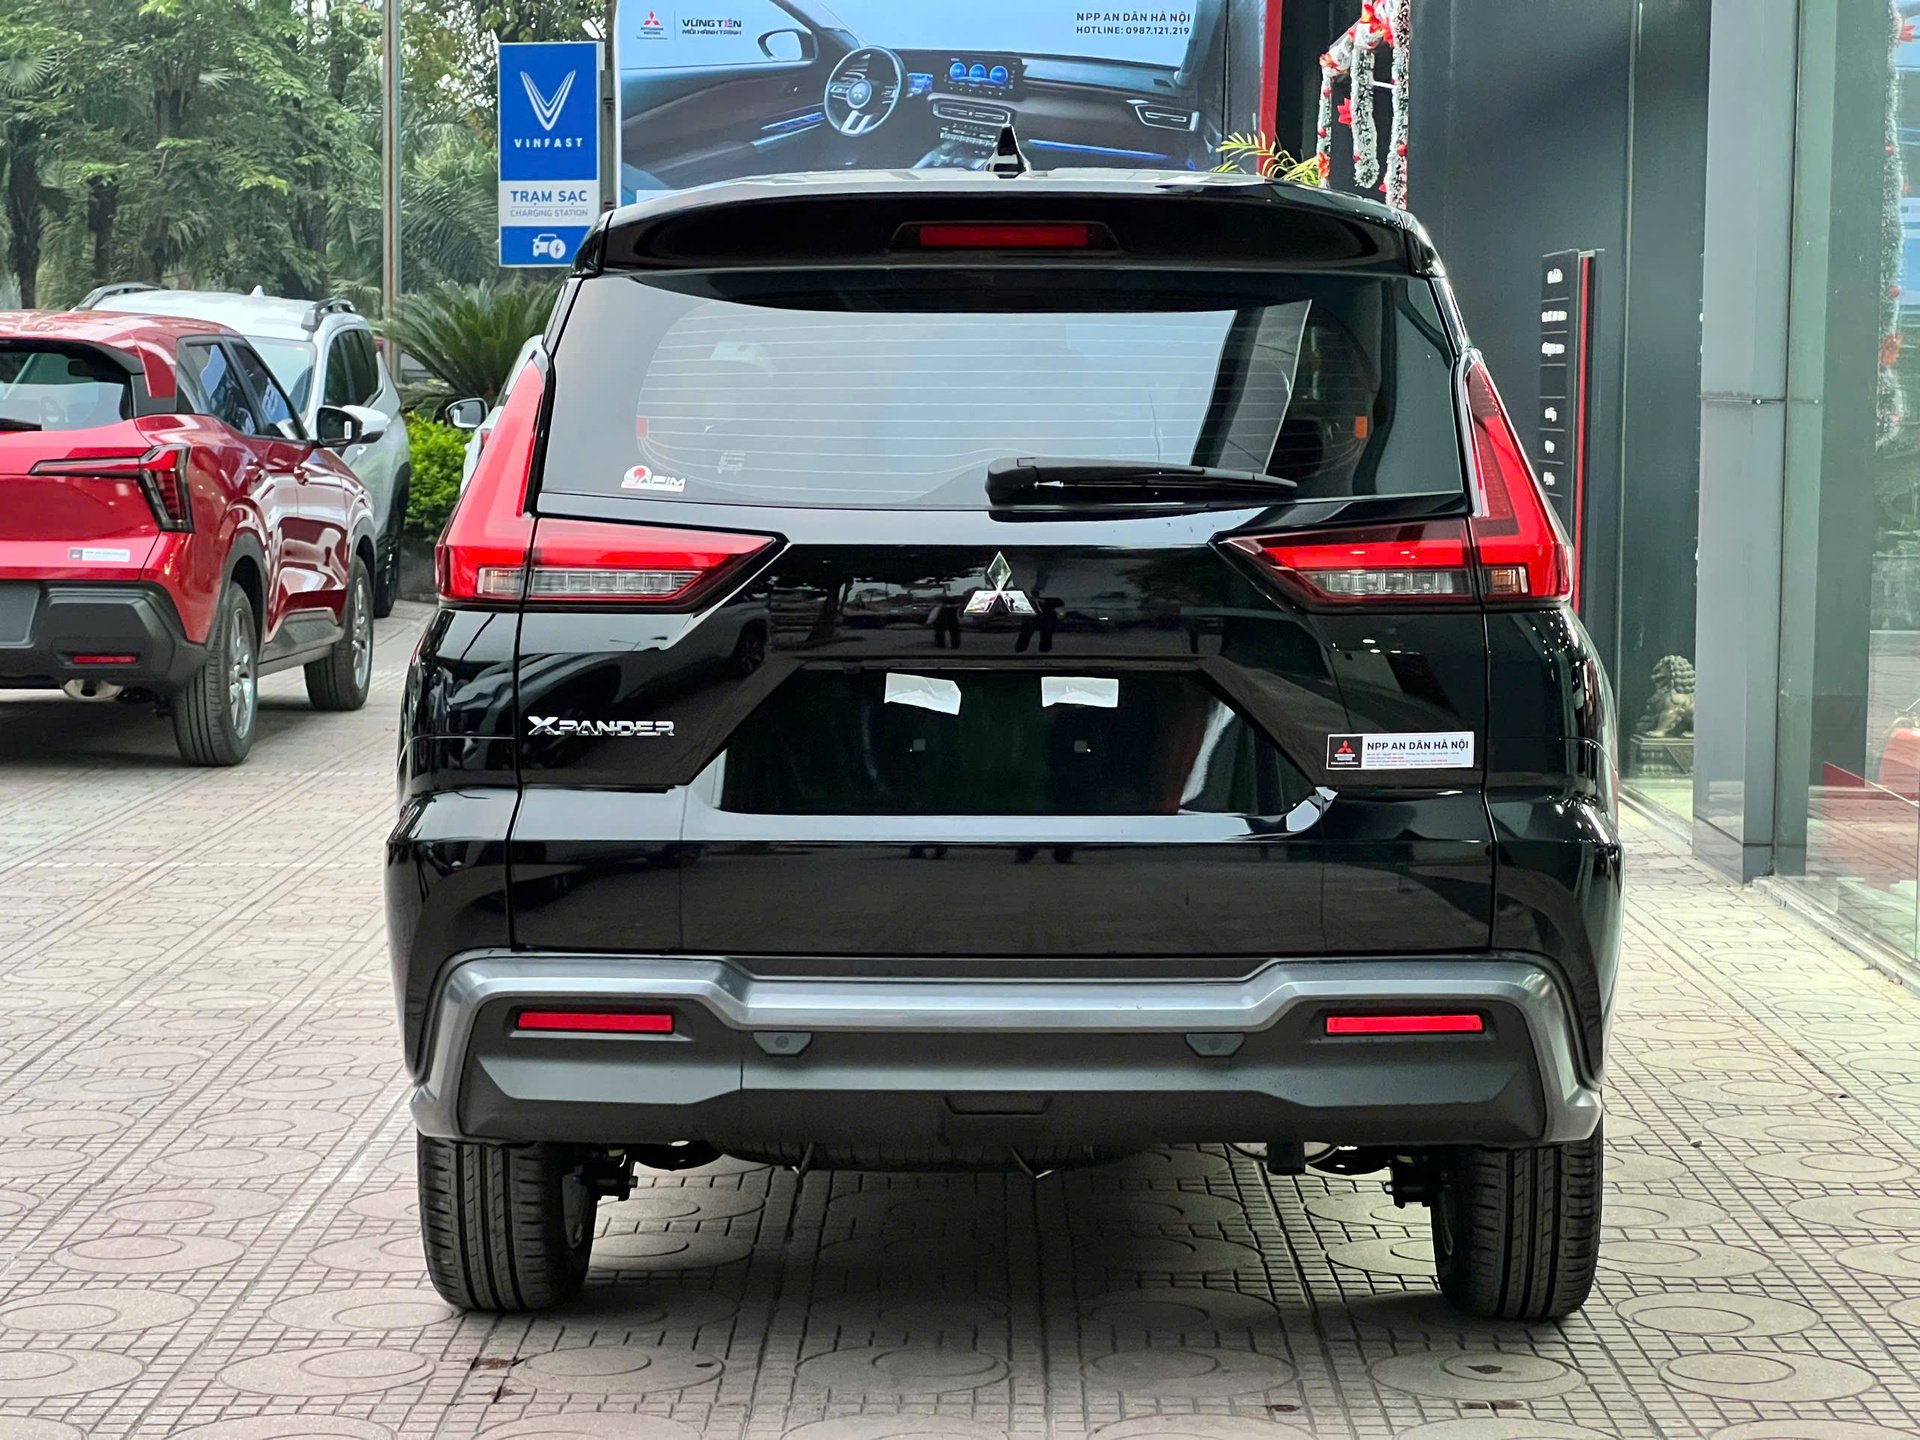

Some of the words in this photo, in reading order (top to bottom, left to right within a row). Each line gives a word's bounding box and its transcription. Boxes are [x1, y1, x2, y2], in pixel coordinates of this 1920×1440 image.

[682, 18, 715, 27] VỮNG
[1076, 12, 1101, 22] NPP
[1103, 12, 1120, 22] AN
[1123, 11, 1147, 22] DÂN
[1150, 10, 1167, 22] HÀ
[1170, 11, 1191, 25] NỘI
[1076, 26, 1123, 34] HOTLINE:
[1125, 26, 1190, 35] 0987.121.219
[514, 137, 583, 148] VINFAST
[510, 190, 553, 206] TRẠM
[558, 190, 588, 206] SẠC
[510, 209, 553, 217] CHARGING
[554, 209, 588, 217] STATION
[527, 715, 675, 737] XPANDER
[1367, 742, 1389, 751] NPP
[1392, 742, 1406, 750] AN
[1409, 740, 1431, 750] DÂN
[1433, 739, 1448, 750] HÀ
[1451, 738, 1469, 751] NỘI
